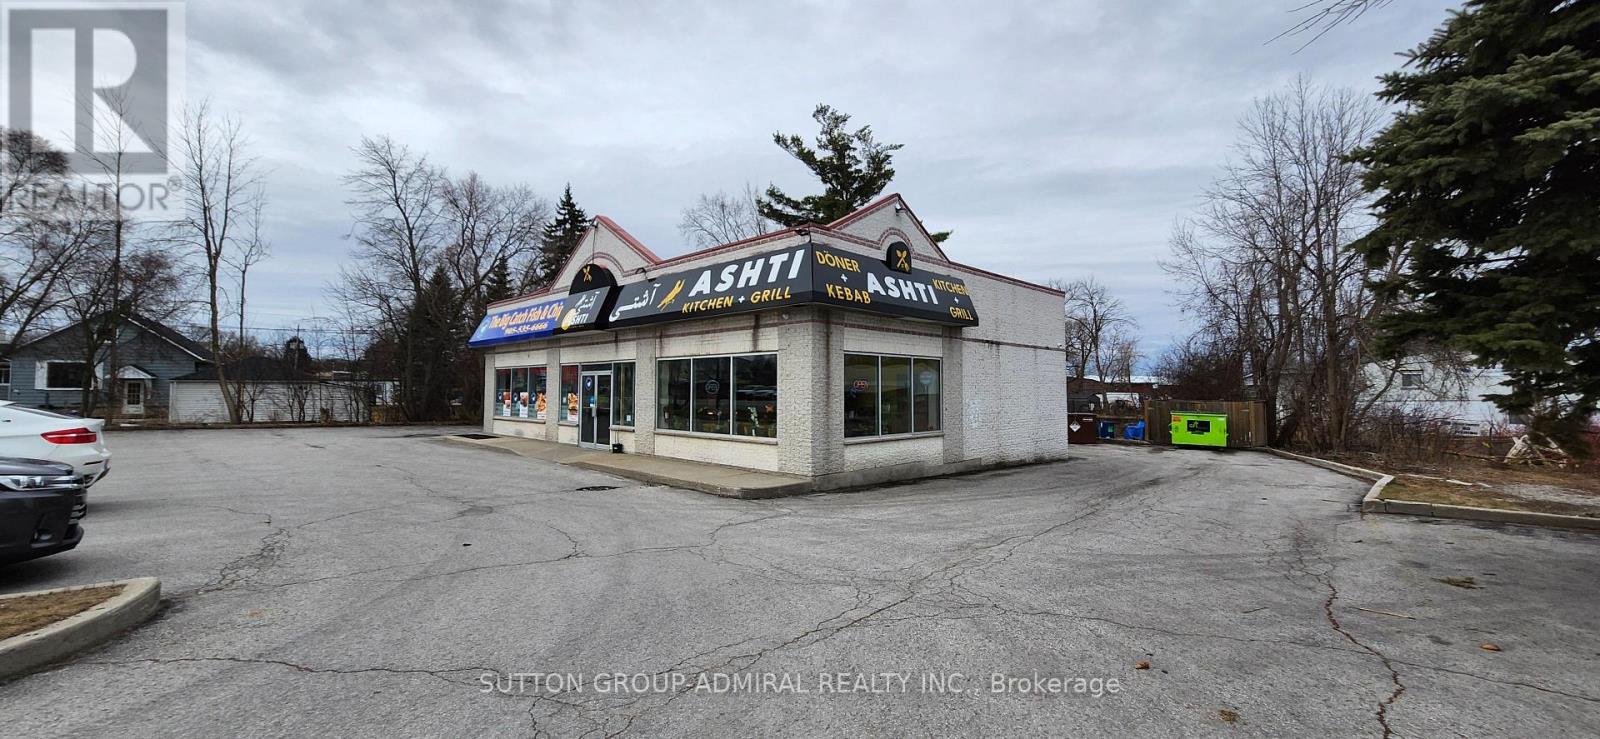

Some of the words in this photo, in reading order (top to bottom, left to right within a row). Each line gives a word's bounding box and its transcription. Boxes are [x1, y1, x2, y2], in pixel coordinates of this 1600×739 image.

[815, 250, 861, 273] DÖNER
[688, 249, 805, 297] ASHTI
[825, 283, 871, 304] KEBAB
[867, 272, 939, 305] ASHTI
[931, 278, 970, 296] KITCHEN
[682, 295, 734, 314] KITCHEN
[750, 286, 792, 304] GRILL
[509, 309, 528, 325] Catch
[526, 305, 542, 323] Fish
[949, 306, 974, 321] GRILL
